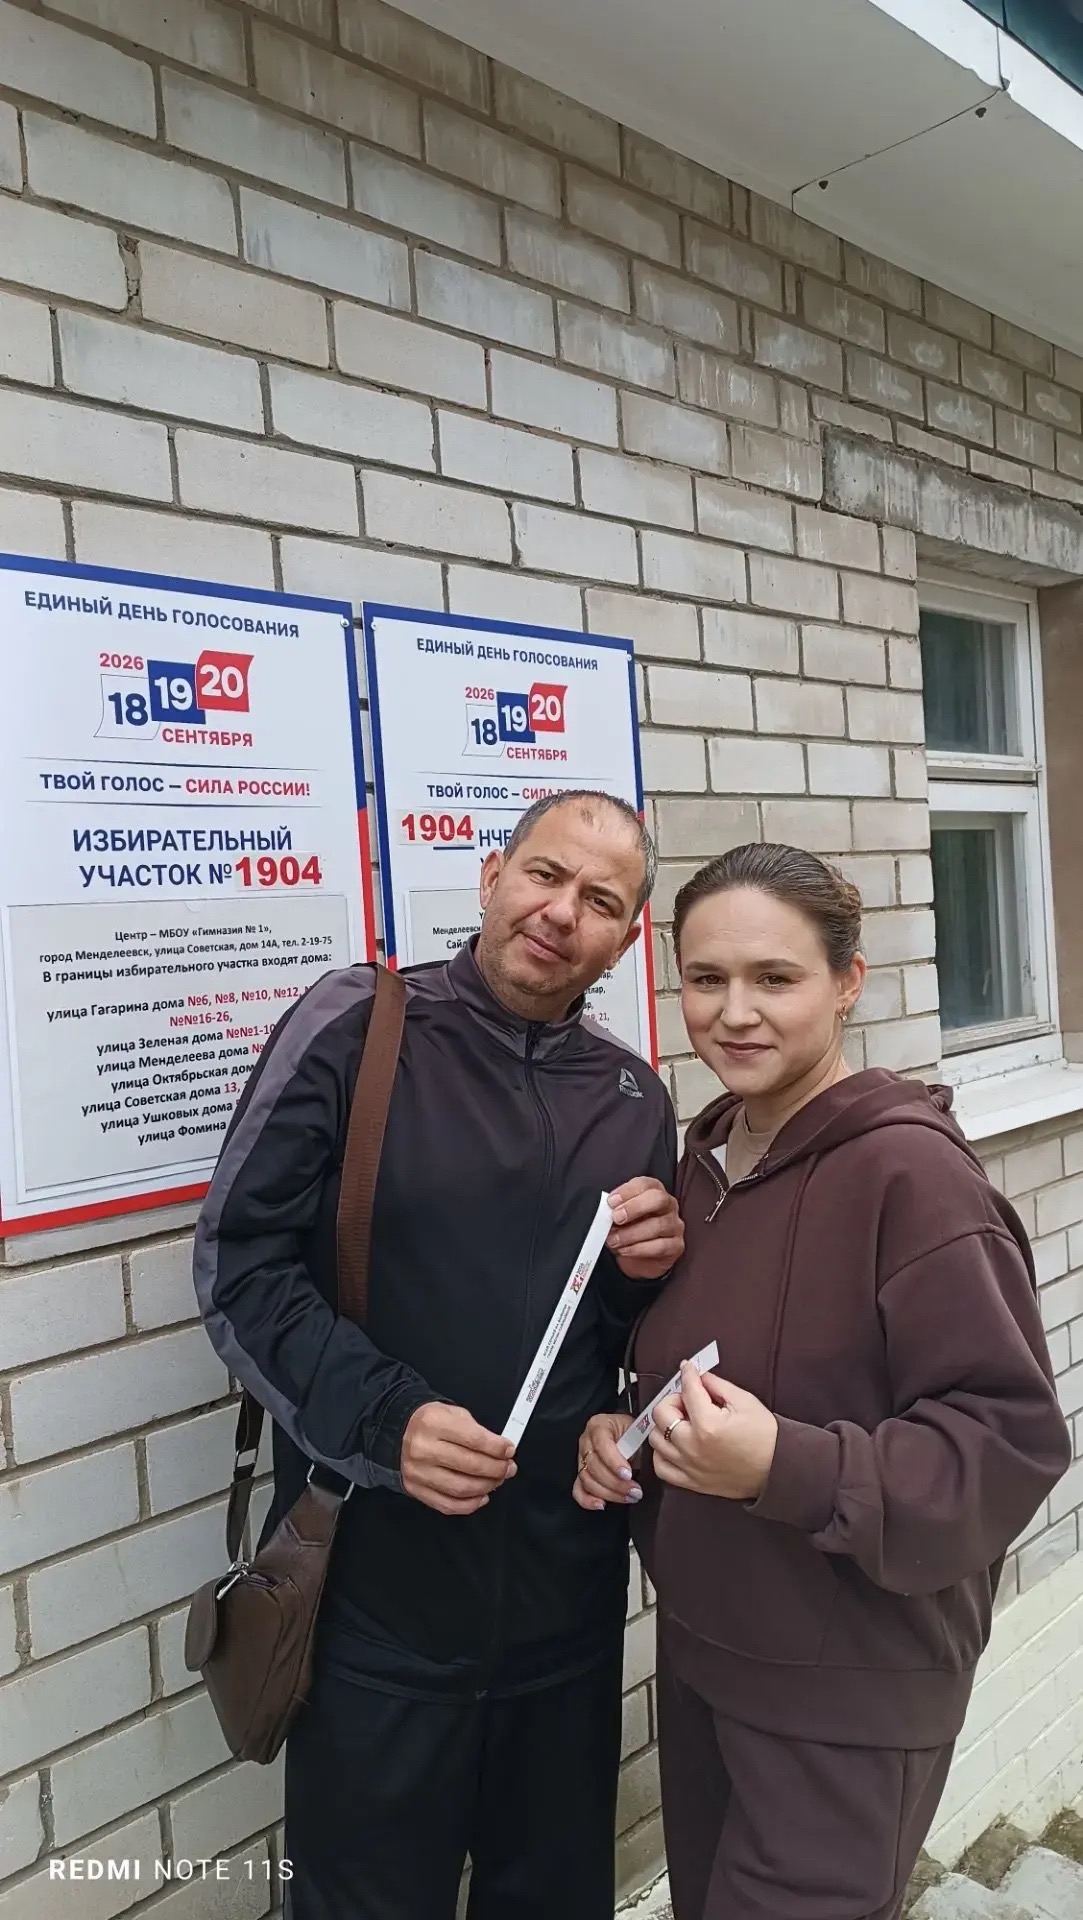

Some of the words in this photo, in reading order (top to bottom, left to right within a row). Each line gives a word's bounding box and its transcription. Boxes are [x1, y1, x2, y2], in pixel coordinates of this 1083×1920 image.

[25, 591, 112, 616] ЕДИНЫЙ
[118, 602, 168, 622] ДЕНЬ
[172, 610, 300, 638] ГОЛОСОВАНИЯ
[100, 653, 144, 670] 2026
[416, 638, 474, 656] ЕДИНЫЙ
[477, 645, 510, 660] ДЕНЬ
[513, 650, 598, 670] ГОЛОСОВАНИЯ
[108, 692, 149, 726] 18
[154, 677, 193, 711] 19
[200, 665, 244, 699] 20
[465, 686, 495, 700] 2026
[471, 718, 497, 745] 18
[501, 705, 527, 733] 19
[531, 693, 561, 721] 20
[162, 728, 253, 747] СЕНТЯБРЯ
[506, 747, 567, 761] СЕНТЯБРЯ
[40, 770, 95, 791] ТВОЙ
[101, 776, 164, 792] ГОЛОС
[185, 778, 234, 795] СИЛА
[238, 781, 311, 797] РОССИИ!
[427, 783, 463, 798] ТВОЙ
[467, 786, 508, 799] ГОЛОС
[73, 825, 292, 852] ИЗБИРАТЕЛЬНЫЙ
[401, 813, 474, 841] 1904
[79, 864, 201, 888] УЧАСТОК
[115, 930, 147, 942] Центр
[159, 928, 189, 938] МБОУ
[192, 926, 243, 937] «Гимназия
[245, 925, 256, 934] №
[39, 952, 73, 964] город
[75, 948, 152, 961] Менделеевск,
[154, 945, 185, 958] улица
[187, 942, 237, 954] Советская,
[239, 942, 259, 952] дом
[261, 940, 280, 949] 14А,
[301, 936, 333, 946] 2-19-75
[43, 971, 51, 982] В
[55, 968, 113, 984] границы
[116, 961, 215, 977] избирательного
[218, 958, 258, 972] участка
[262, 955, 298, 967] входят
[301, 953, 332, 965] дома:
[47, 1007, 87, 1023] улица
[91, 1002, 149, 1016] Гагарина
[152, 999, 185, 1012] дома
[188, 995, 212, 1007] №6,
[215, 993, 238, 1005] №8,
[242, 990, 270, 1001] №10,
[170, 1011, 233, 1027] №№16-26,
[96, 1041, 135, 1056] улица
[139, 1034, 189, 1050] Зеленая
[192, 1030, 223, 1045] дома
[96, 1061, 135, 1076] улица
[139, 1051, 215, 1068] Менделеева
[218, 1045, 249, 1060] дома
[111, 1077, 149, 1093] улица
[152, 1068, 228, 1086] Октябрьская
[81, 1100, 121, 1116] улица
[124, 1090, 186, 1107] Советская
[189, 1086, 220, 1101] дома
[224, 1081, 240, 1094] 13,
[100, 1117, 139, 1133] улица
[142, 1108, 199, 1125] Ушковых
[202, 1102, 233, 1117] дома
[138, 1130, 175, 1146] улица
[178, 1121, 226, 1137] Фомина
